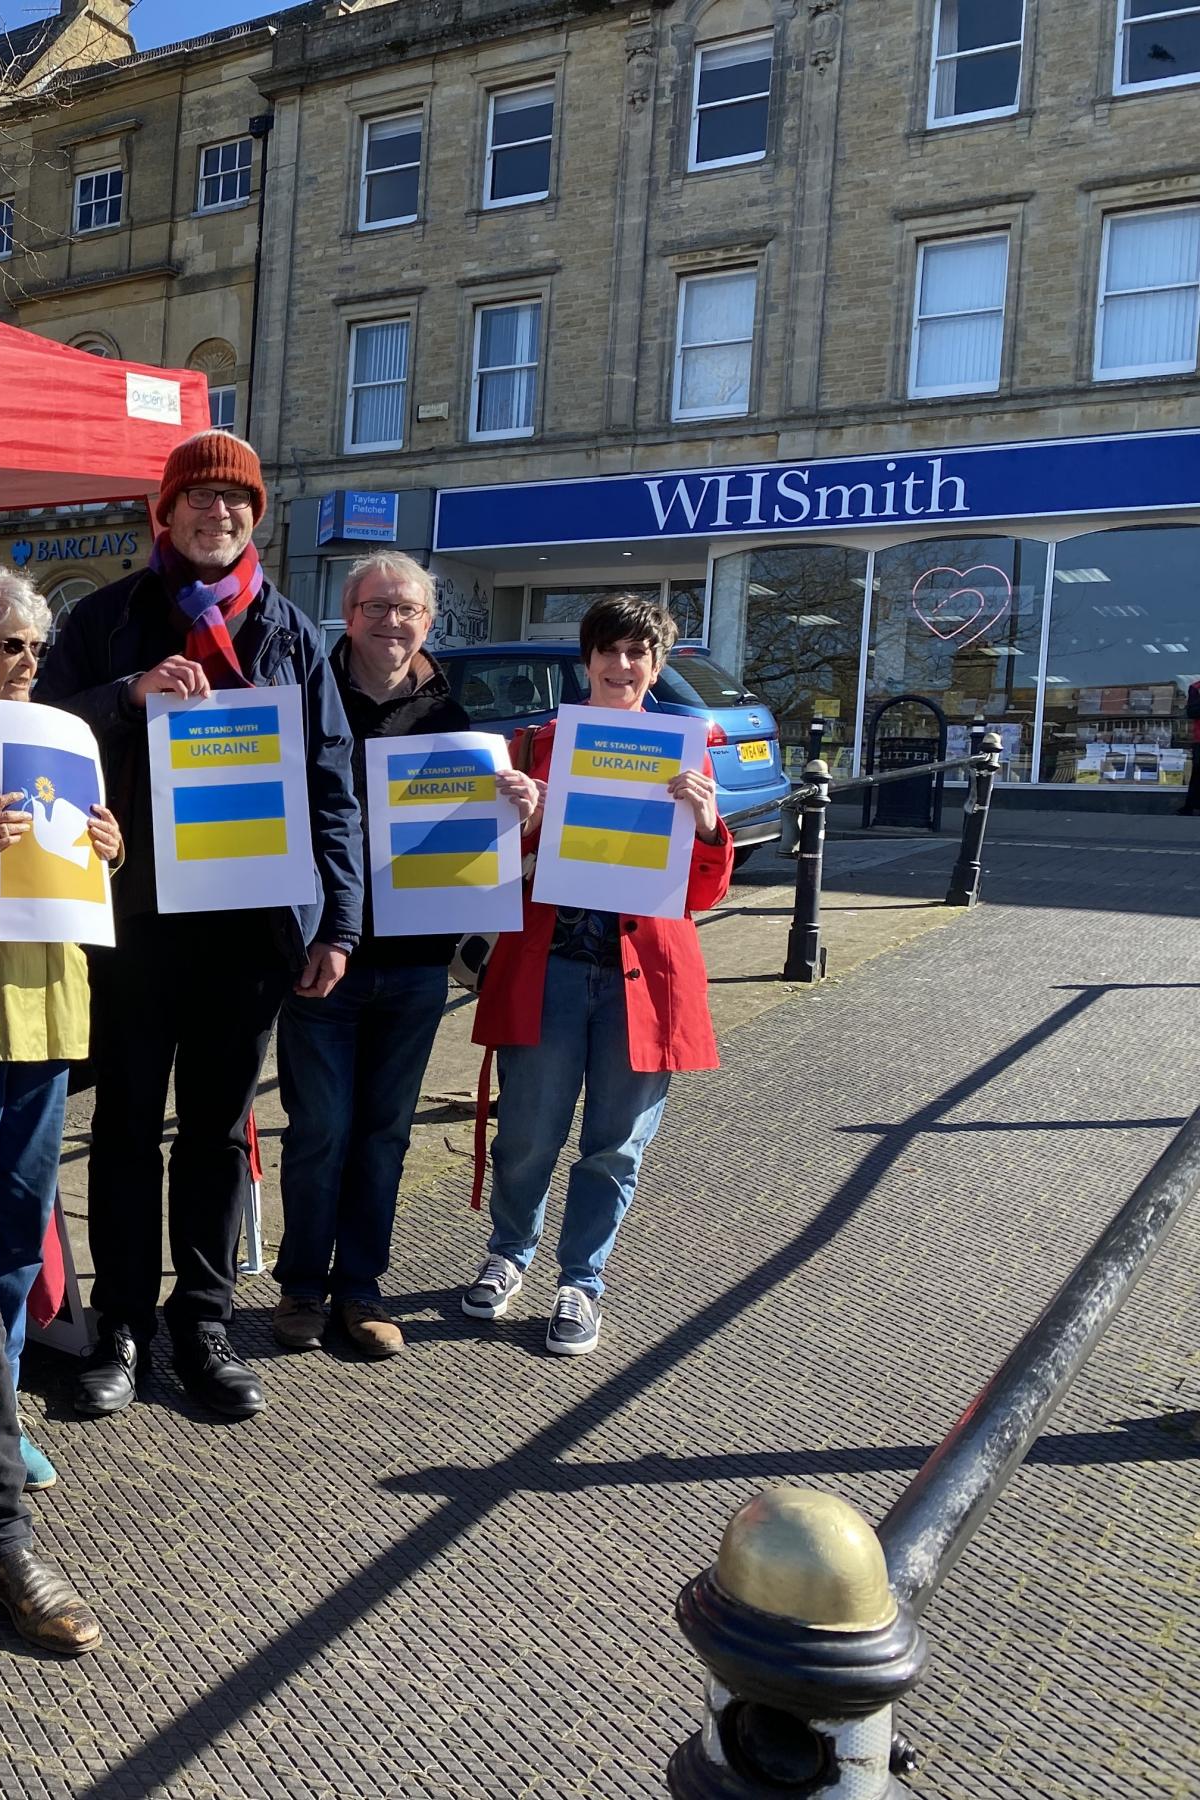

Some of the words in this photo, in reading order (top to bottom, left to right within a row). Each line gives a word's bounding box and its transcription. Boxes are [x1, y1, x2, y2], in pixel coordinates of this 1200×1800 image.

[352, 494, 379, 505] Tayler
[380, 496, 387, 505] &
[643, 457, 971, 531] WHSmith
[352, 504, 387, 514] Fletcher
[346, 527, 369, 536] OFFICES
[380, 529, 391, 537] LET
[36, 530, 138, 562] BARCLAYS
[188, 727, 203, 735] WE
[205, 725, 233, 735] STAND
[235, 723, 259, 733] WITH
[190, 740, 260, 757] UKRAINE
[594, 740, 608, 748] WE
[610, 741, 638, 751] STAND
[639, 744, 663, 753] WITH
[882, 751, 929, 761] LITTER
[407, 768, 421, 776] WE
[422, 767, 451, 775] STAND
[452, 765, 476, 774] WITH
[592, 756, 661, 773] UKRAINE
[408, 780, 477, 796] UKRAINE
